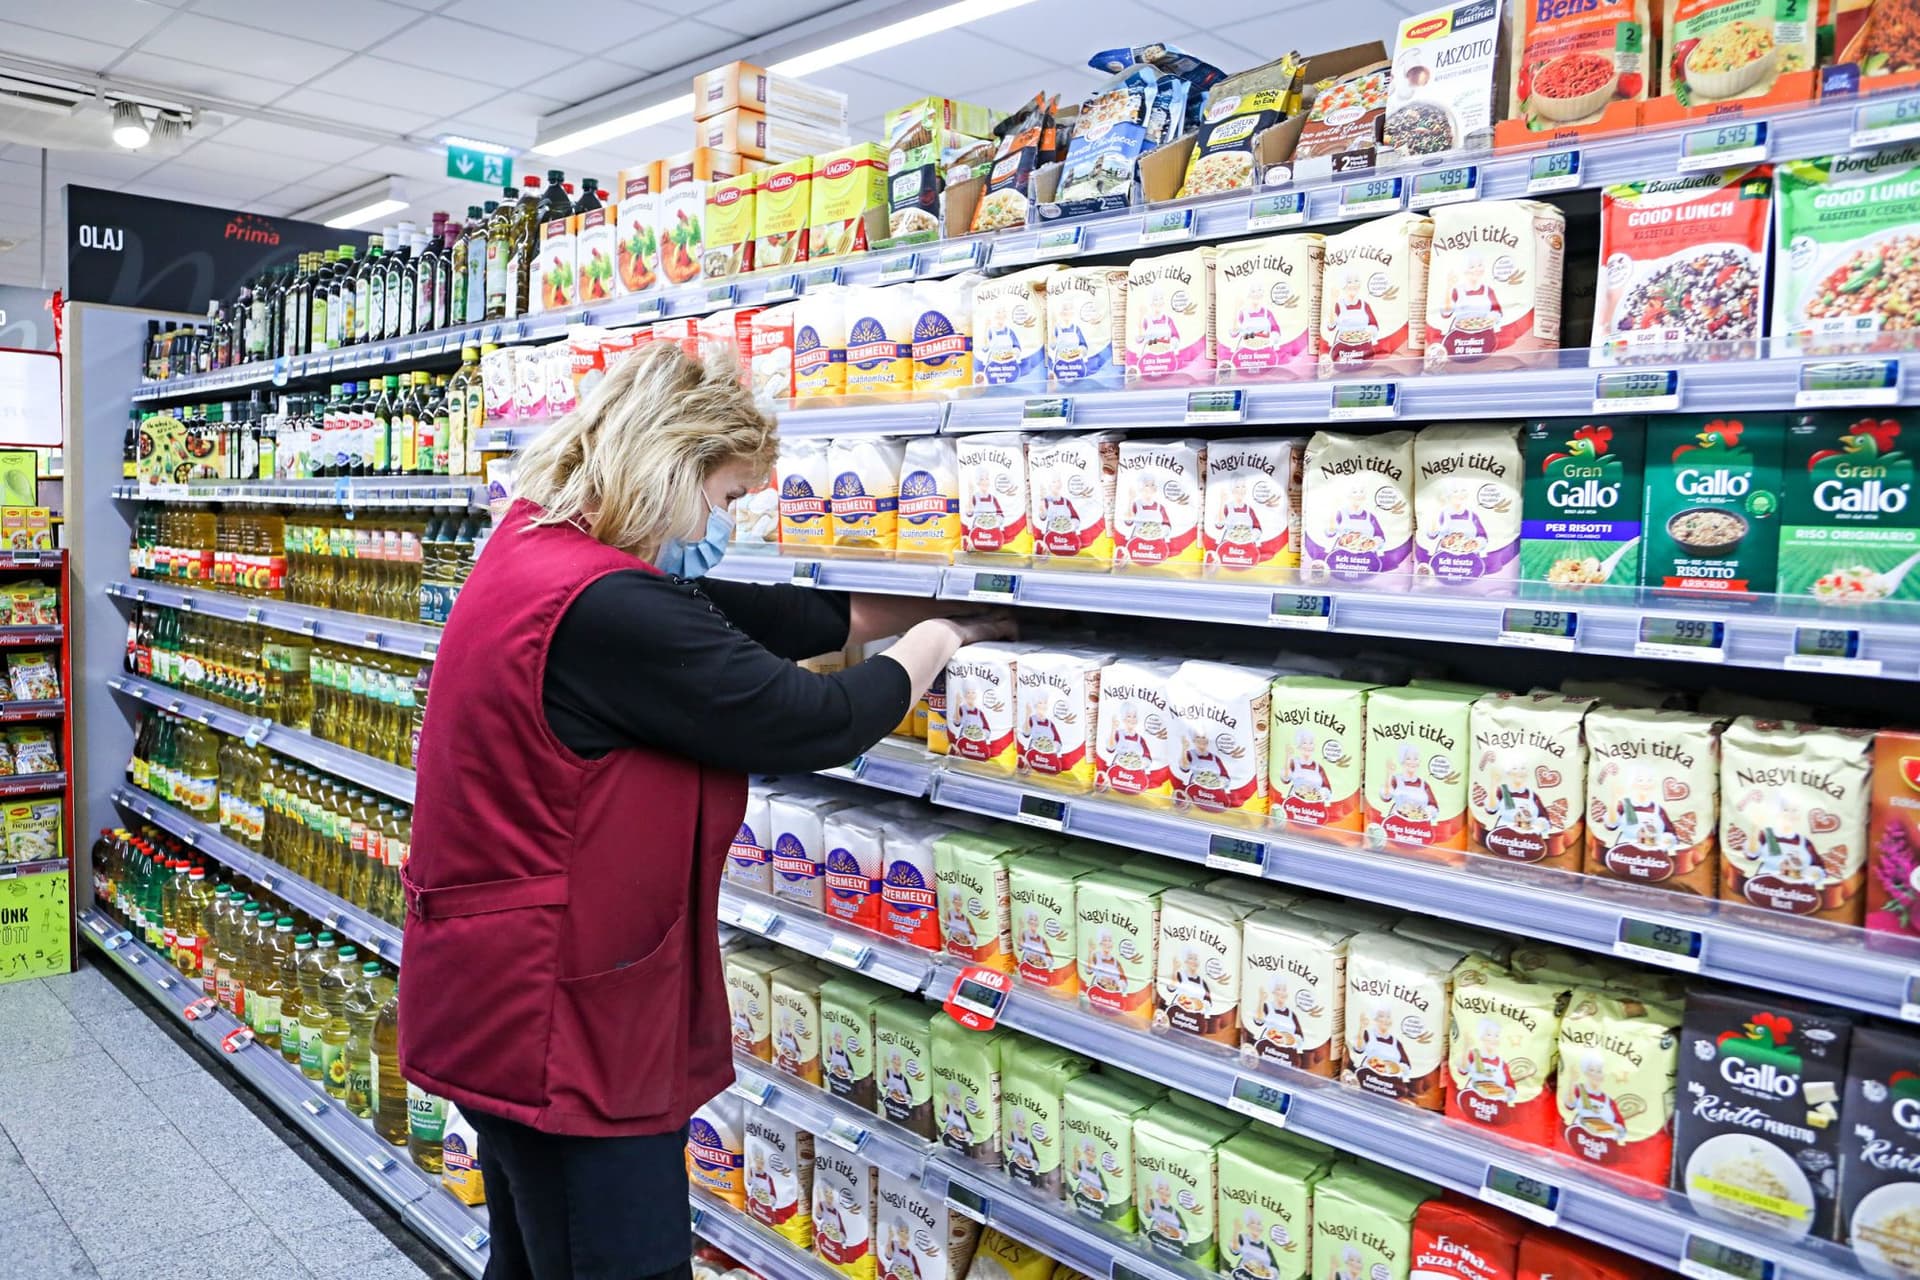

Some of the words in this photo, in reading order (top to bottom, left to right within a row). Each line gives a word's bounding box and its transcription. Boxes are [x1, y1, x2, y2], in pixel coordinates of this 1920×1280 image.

[1625, 27, 1637, 42] 2
[1435, 37, 1494, 69] KASZOTTO
[1256, 89, 1280, 99] Ready
[1260, 96, 1276, 105] Eat
[1716, 127, 1746, 145] 649
[826, 161, 853, 177] LAGRIS
[1341, 157, 1351, 171] 2
[1548, 154, 1570, 172] 649
[1836, 147, 1920, 174] Bonduelle
[769, 174, 794, 188] LAGRIS
[1367, 181, 1389, 197] 999
[1439, 169, 1462, 185] 499
[1647, 173, 1721, 194] Bonduelle
[716, 191, 738, 203] LAGRIS
[1273, 195, 1294, 211] 599
[1628, 209, 1672, 227] GOOD
[1675, 201, 1734, 222] LUNCH
[79, 224, 124, 252] OLAJ
[225, 223, 280, 246] Prima
[1433, 225, 1479, 257] Nagyi
[1482, 225, 1519, 249] titka
[1360, 245, 1393, 266] titka
[1128, 269, 1163, 291] Nagyi
[1164, 266, 1192, 286] titka
[1224, 255, 1262, 282] Nagyi
[1263, 255, 1294, 277] titka
[958, 450, 987, 469] Nagyi
[988, 449, 1012, 470] titka
[1062, 451, 1087, 471] titka
[1119, 452, 1152, 472] Nagyi
[1155, 452, 1185, 476] titka
[1210, 452, 1244, 475] Nagyi
[1247, 453, 1276, 477] titka
[1321, 455, 1362, 480] Nagyi
[1366, 455, 1403, 482] titka
[1421, 453, 1463, 480] Nagyi
[1468, 453, 1506, 479] titka
[1563, 464, 1602, 478] Gran
[1835, 462, 1887, 480] Gran
[1547, 480, 1621, 508] Gallo
[1675, 469, 1752, 497] Gallo
[1813, 480, 1911, 513] Gallo
[1545, 524, 1567, 533] PER
[1568, 524, 1612, 534] RISOTTI
[1795, 529, 1828, 541] RISO
[1830, 530, 1917, 543] ORIGINARIO
[1676, 567, 1735, 579] RISOTTO
[1296, 596, 1317, 611] 359
[1675, 621, 1706, 639] 999
[947, 664, 974, 680] Nagyi
[975, 664, 1000, 686] titka
[1019, 672, 1046, 688] Nagyi
[1048, 673, 1072, 696] titka
[1103, 684, 1134, 699] Nagyi
[1137, 687, 1167, 711] titka
[1206, 704, 1237, 729] titka
[1274, 707, 1310, 726] Nagyi
[1314, 709, 1347, 736] titka
[1373, 721, 1415, 741] Nagyi
[1419, 722, 1456, 751] titka
[1476, 729, 1524, 751] Nagyi
[1528, 732, 1566, 760] titka
[1593, 738, 1646, 760] Nagyi
[1652, 741, 1695, 770] titka
[1736, 765, 1796, 787] Nagyi
[1801, 768, 1846, 800] titka
[960, 873, 983, 896] titka
[1037, 893, 1062, 915] titka
[1111, 912, 1138, 936] titka
[1163, 925, 1196, 942] Nagyi
[1199, 930, 1228, 955] titka
[974, 970, 1003, 988] AKCIÓ
[1247, 954, 1284, 972] Nagyi
[1288, 959, 1319, 987] titka
[1350, 979, 1391, 997] Nagyi
[1393, 984, 1430, 1014] titka
[840, 1013, 860, 1034] titka
[1455, 994, 1496, 1014] Nagyi
[1500, 1001, 1537, 1033] titka
[899, 1034, 920, 1057] titka
[1605, 1036, 1642, 1068] titka
[956, 1071, 979, 1095] titka
[1720, 1056, 1800, 1097] Gallo
[1257, 1086, 1278, 1103] 359
[1023, 1094, 1046, 1120] titka
[764, 1127, 786, 1153] titka
[1093, 1125, 1119, 1150] titka
[835, 1160, 858, 1187] titka
[1168, 1162, 1197, 1188] titka
[908, 1199, 936, 1229] titka
[1222, 1186, 1257, 1204] Nagyi
[1260, 1194, 1292, 1222] titka
[983, 1229, 1021, 1264] RIZS
[1319, 1221, 1357, 1241] Nagyi
[1360, 1231, 1396, 1261] titka
